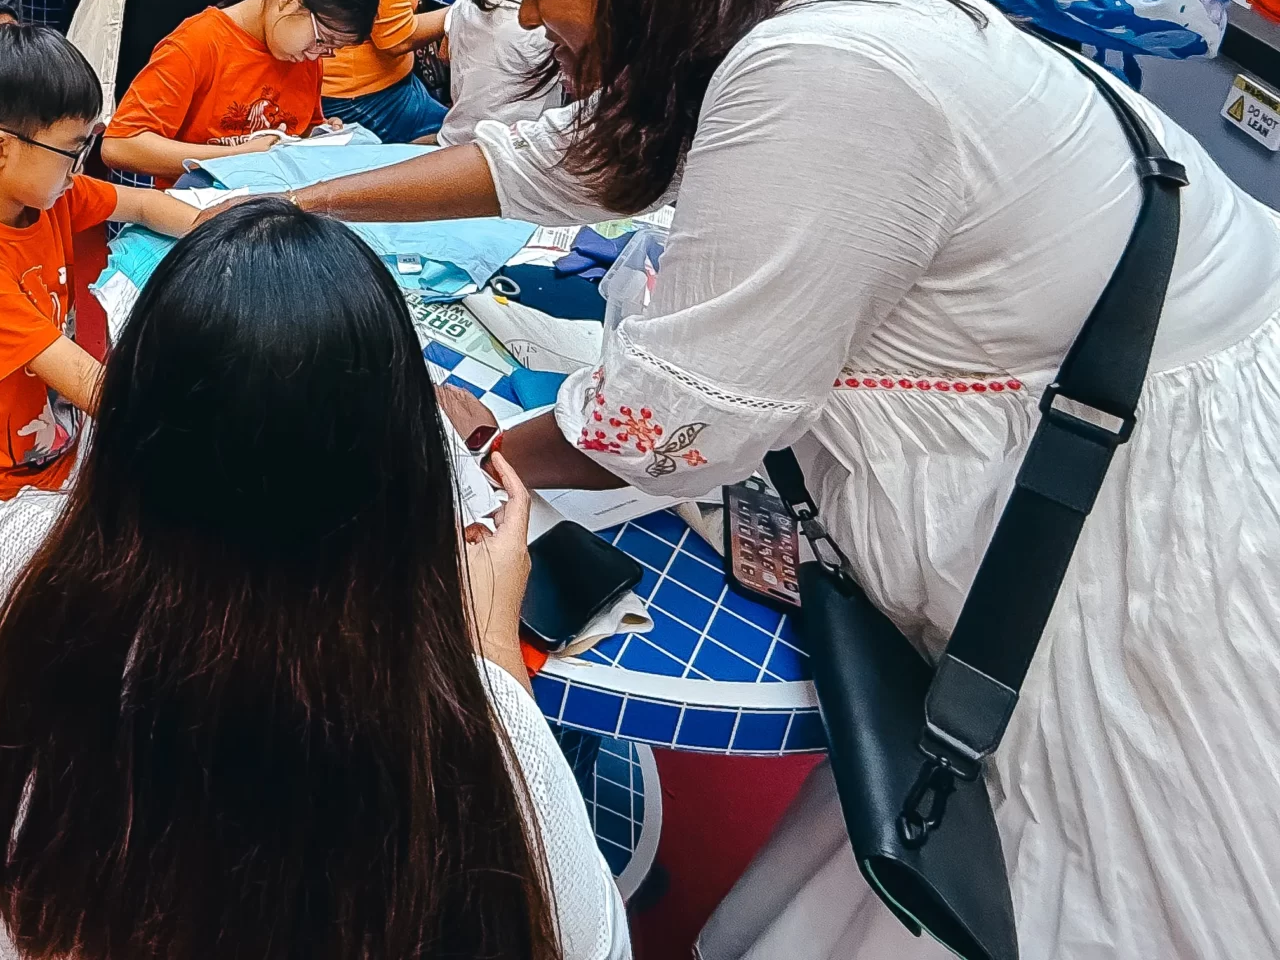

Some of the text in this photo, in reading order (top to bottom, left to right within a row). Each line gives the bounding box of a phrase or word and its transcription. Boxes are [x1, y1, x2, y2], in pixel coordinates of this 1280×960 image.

[1247, 104, 1279, 130] DO NOT
[1247, 117, 1270, 138] LEAN
